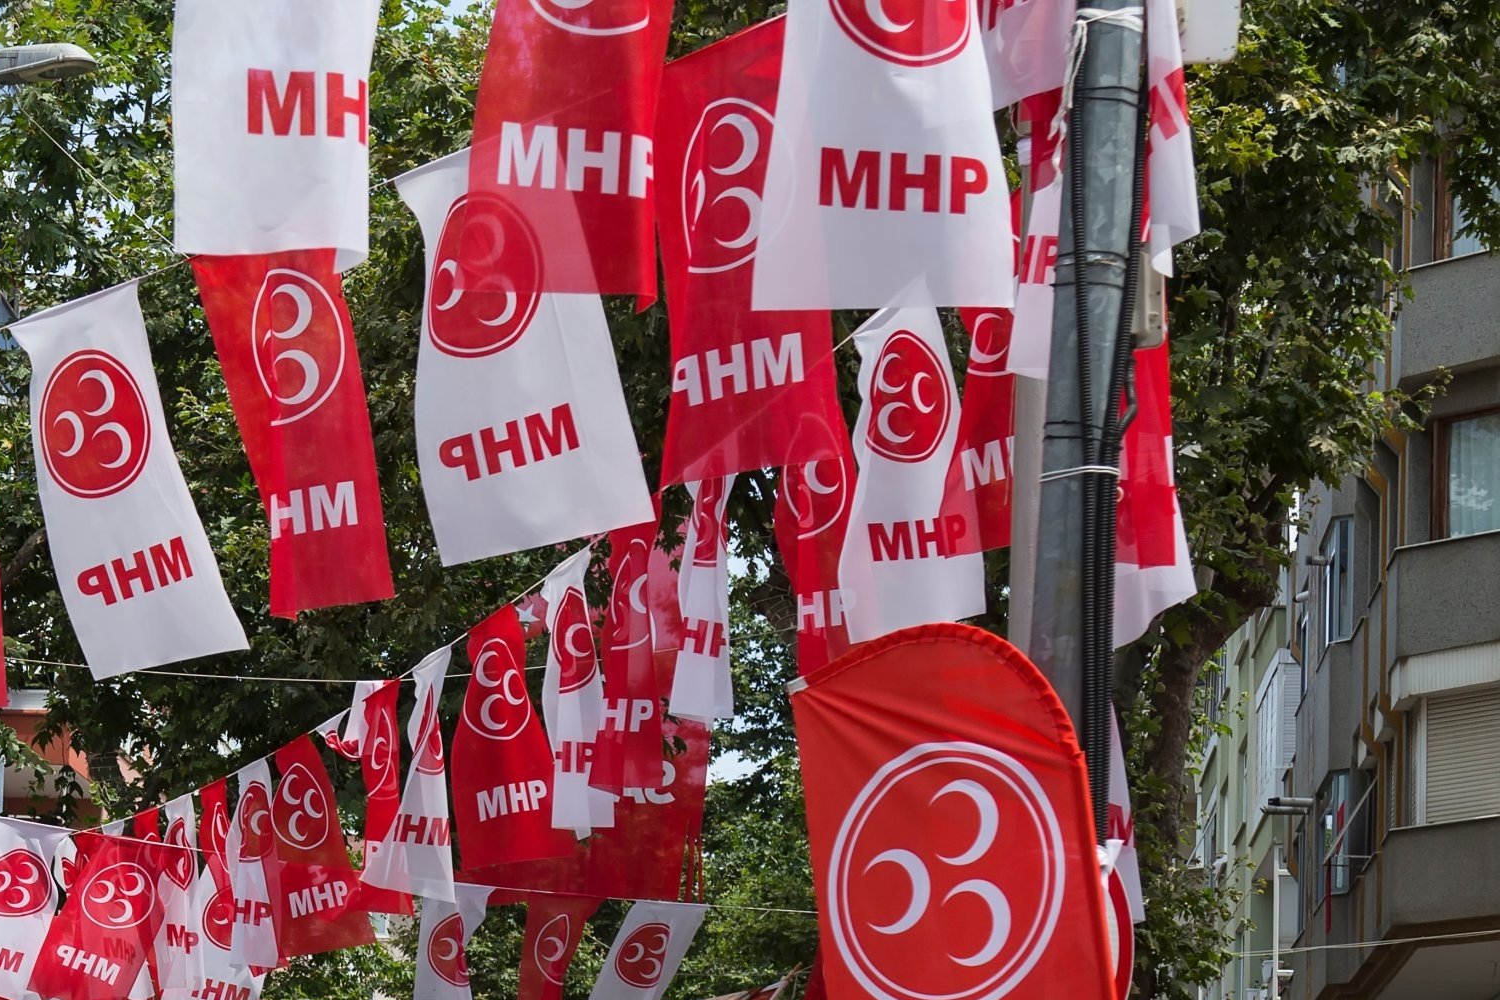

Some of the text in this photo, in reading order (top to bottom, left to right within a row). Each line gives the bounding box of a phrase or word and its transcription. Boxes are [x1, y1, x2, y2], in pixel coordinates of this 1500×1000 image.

[247, 68, 367, 145] MH
[819, 147, 989, 214] MHP
[868, 513, 966, 561] MHP
[797, 588, 856, 631] HP
[601, 698, 654, 734] HP
[476, 779, 548, 822] MHP
[233, 897, 272, 927] HP
[288, 880, 348, 919] MHP
